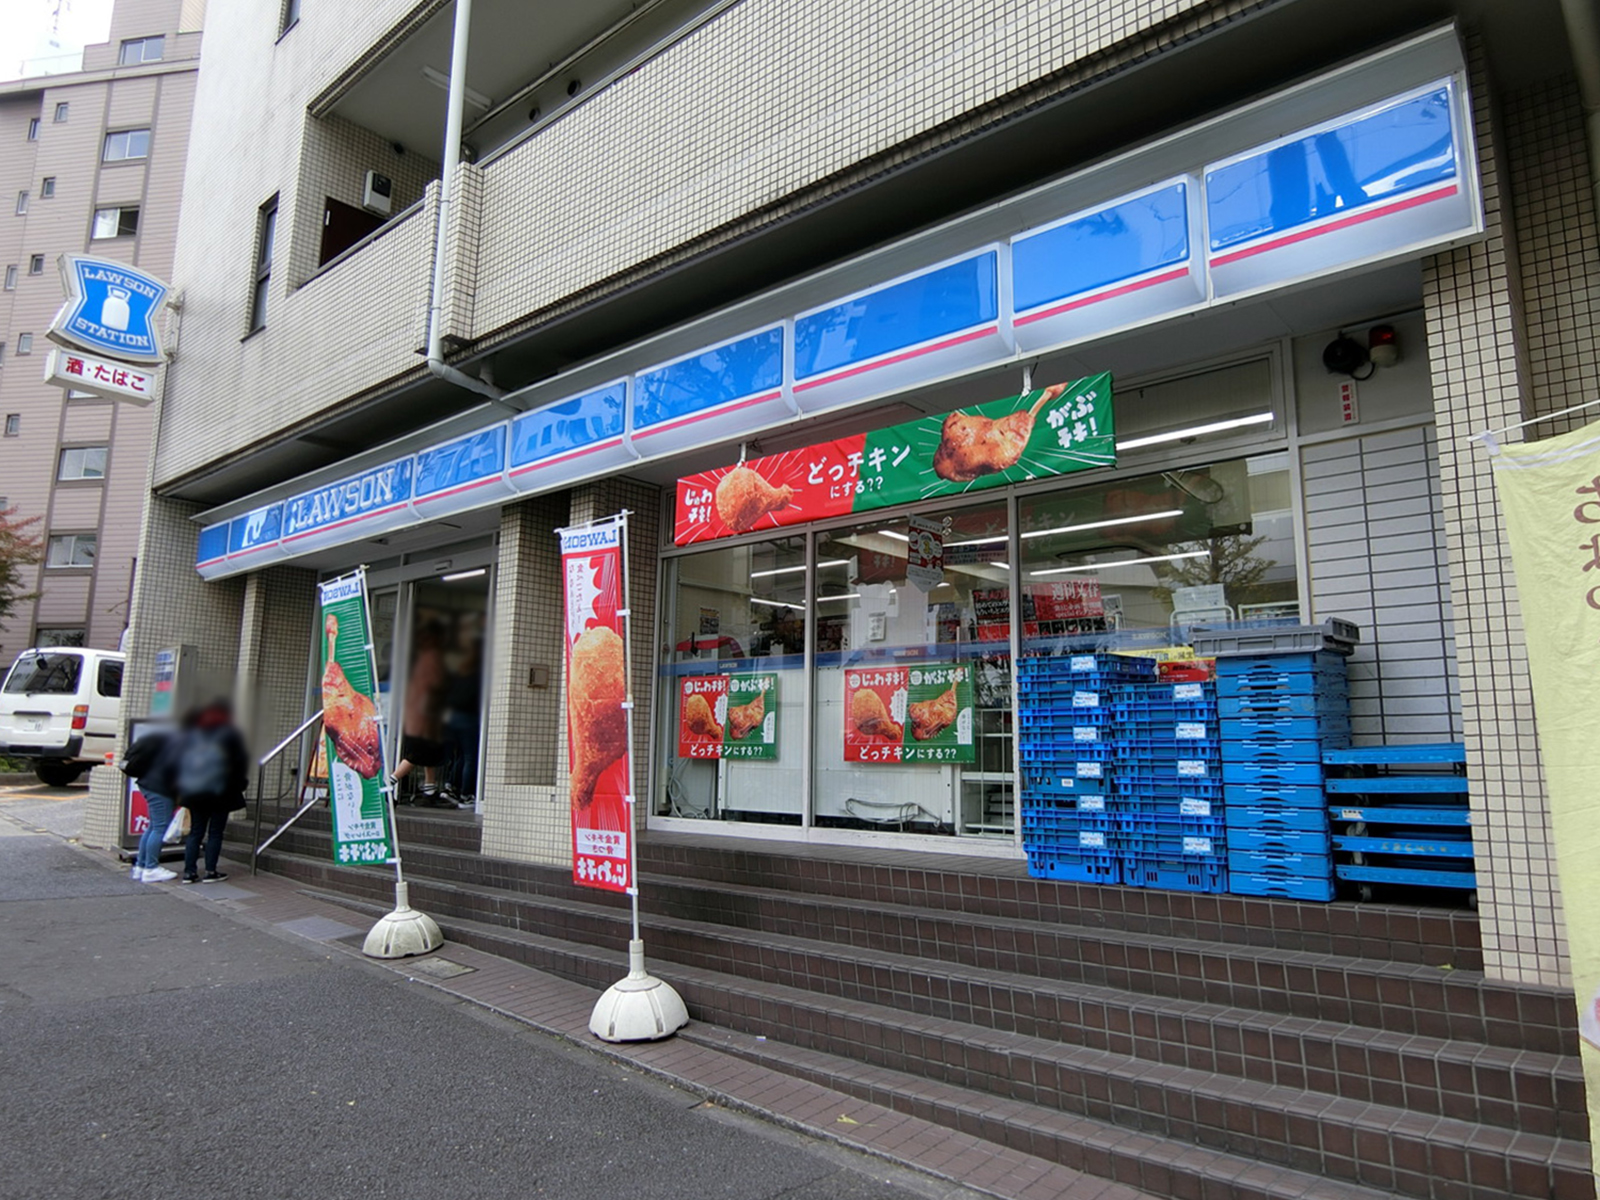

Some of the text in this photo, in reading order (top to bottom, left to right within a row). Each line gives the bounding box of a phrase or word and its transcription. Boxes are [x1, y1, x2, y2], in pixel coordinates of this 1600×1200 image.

[83, 267, 157, 299] LAWSON
[75, 317, 149, 346] STATION
[66, 356, 146, 391] 酒・たばこ
[1046, 390, 1098, 429] がぶ
[807, 445, 911, 486] どっチキン
[293, 468, 396, 529] LAWSON
[830, 475, 884, 500] にする??
[859, 745, 957, 760] どっチキンにする??
